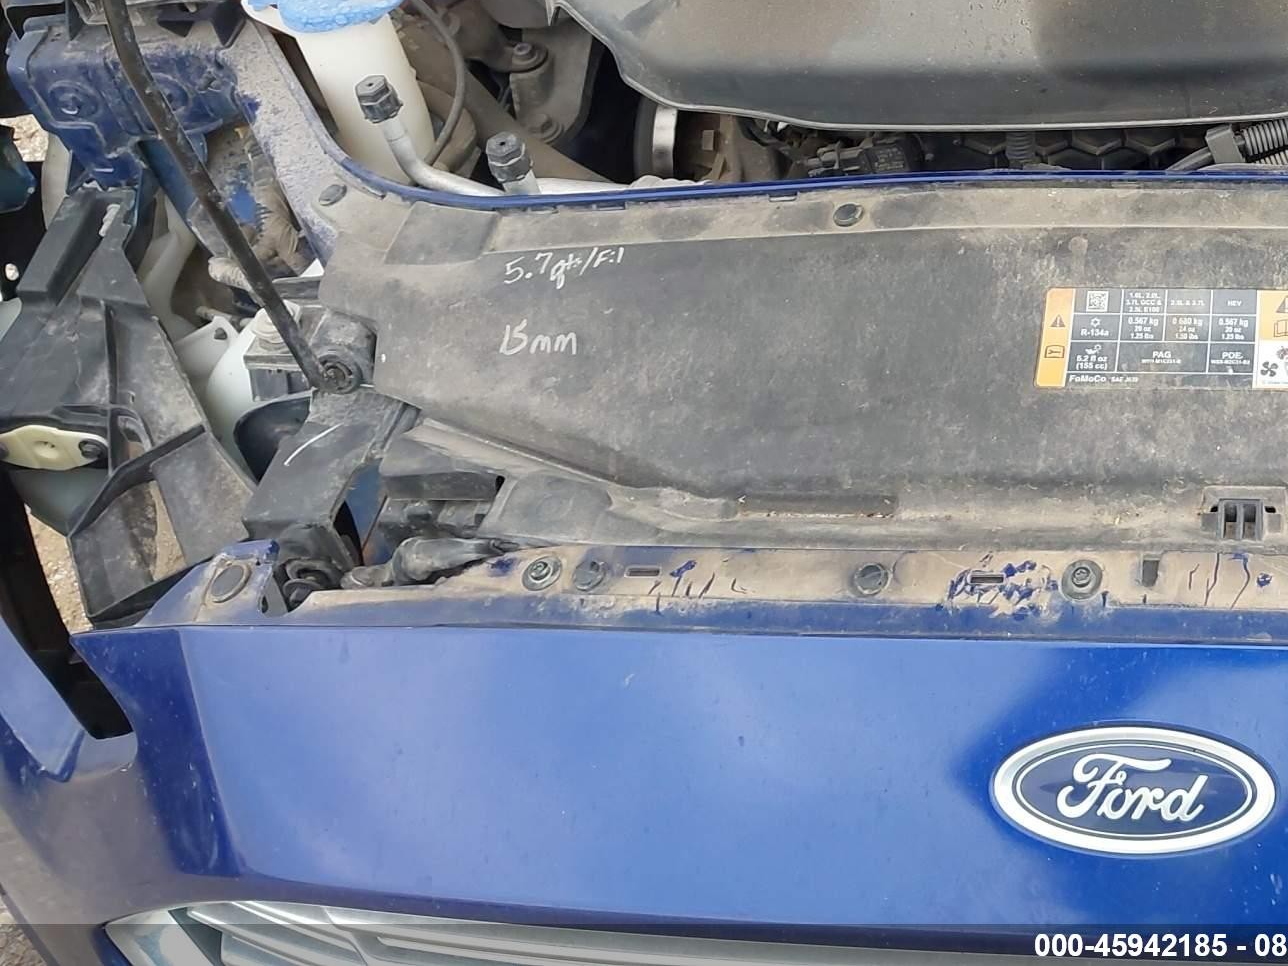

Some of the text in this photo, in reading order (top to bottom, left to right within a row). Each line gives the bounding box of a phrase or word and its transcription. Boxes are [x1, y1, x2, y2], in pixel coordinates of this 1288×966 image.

[1127, 316, 1159, 327] 0.567 kg
[1193, 317, 1204, 327] kg
[1238, 318, 1249, 328] kg
[1080, 328, 1109, 337] R-134a
[1152, 350, 1172, 359] PAG
[1075, 362, 1108, 371] (155 cc)
[1068, 374, 1107, 383] FoMoCo
[1057, 753, 1208, 821] Ford
